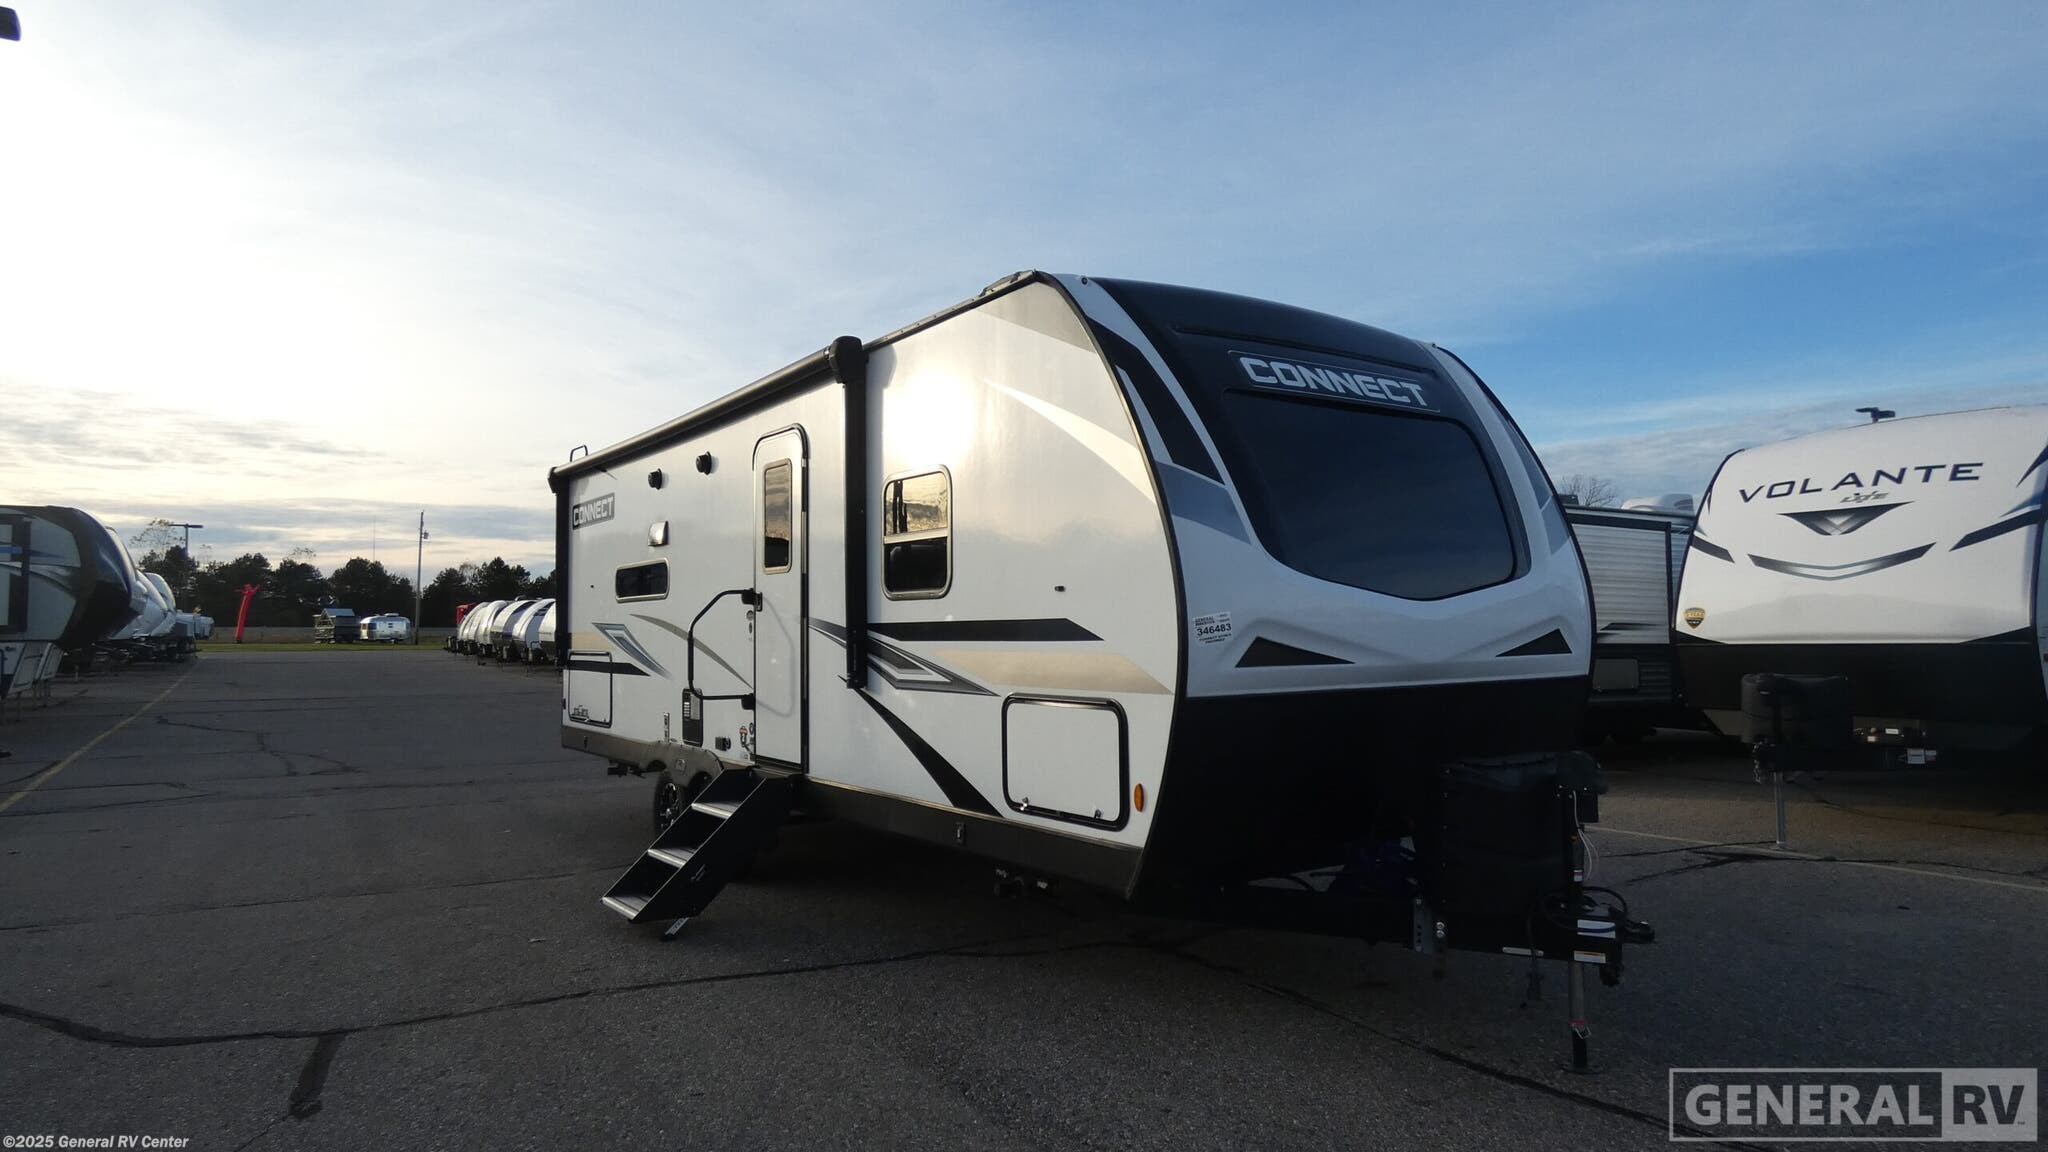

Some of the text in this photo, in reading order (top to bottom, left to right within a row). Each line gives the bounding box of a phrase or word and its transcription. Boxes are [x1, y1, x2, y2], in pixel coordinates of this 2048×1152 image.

[1240, 357, 1428, 406] CONNECT
[1739, 463, 1984, 503] VOLANTE
[573, 496, 614, 526] CONNECT
[1196, 623, 1232, 636] 346483
